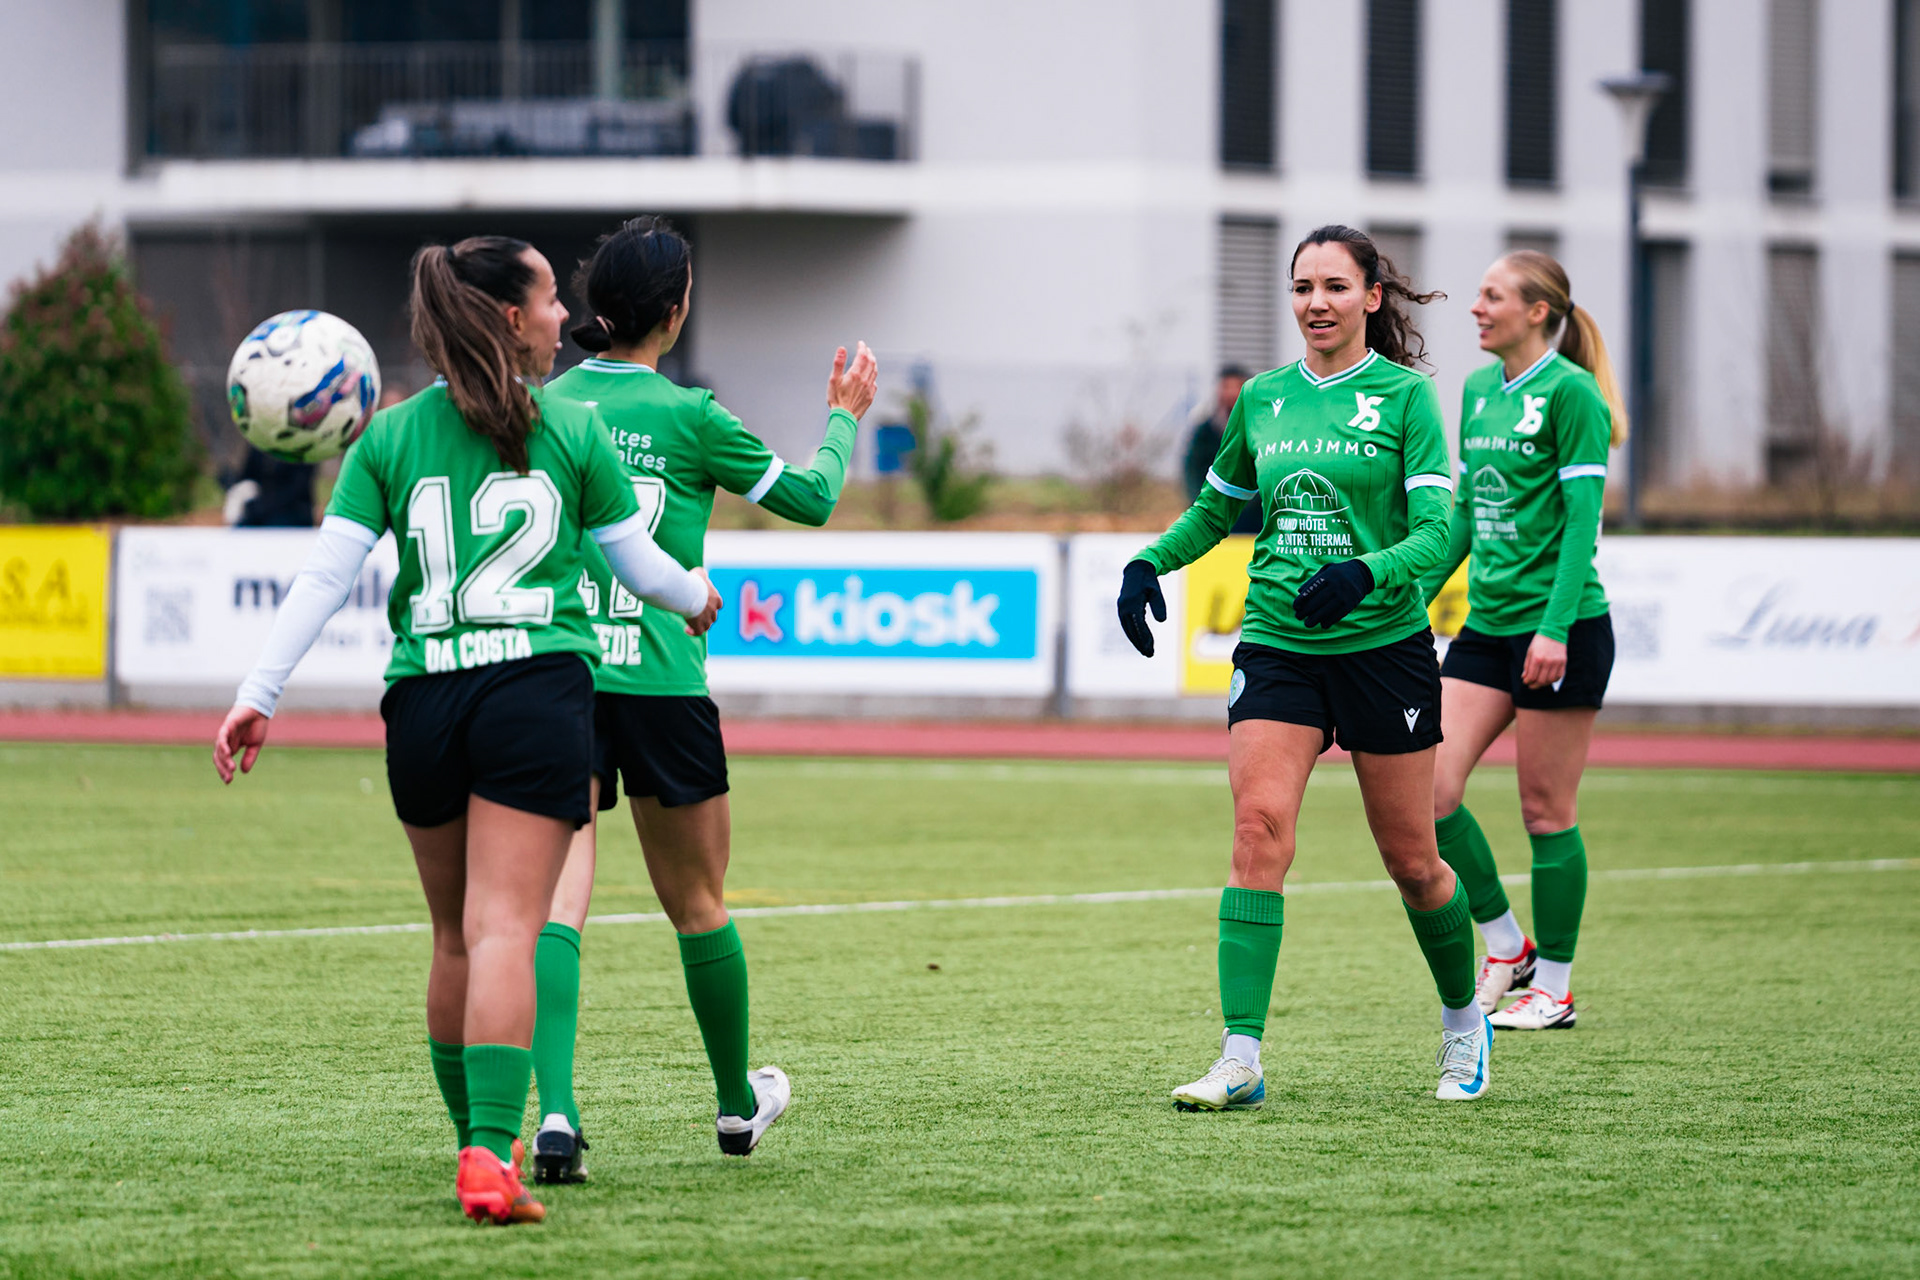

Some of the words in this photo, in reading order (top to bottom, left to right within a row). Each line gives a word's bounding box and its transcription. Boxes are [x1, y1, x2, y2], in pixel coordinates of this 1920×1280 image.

[611, 426, 653, 449] ites
[616, 447, 667, 471] aires
[1299, 515, 1328, 531] HÔTEL
[407, 469, 563, 634] 12
[1277, 533, 1284, 546] &
[1309, 533, 1353, 547] THERMAL
[794, 574, 1000, 646] kiosk
[425, 637, 457, 674] DA
[459, 628, 532, 670] COSTA
[590, 623, 642, 665] EDE
